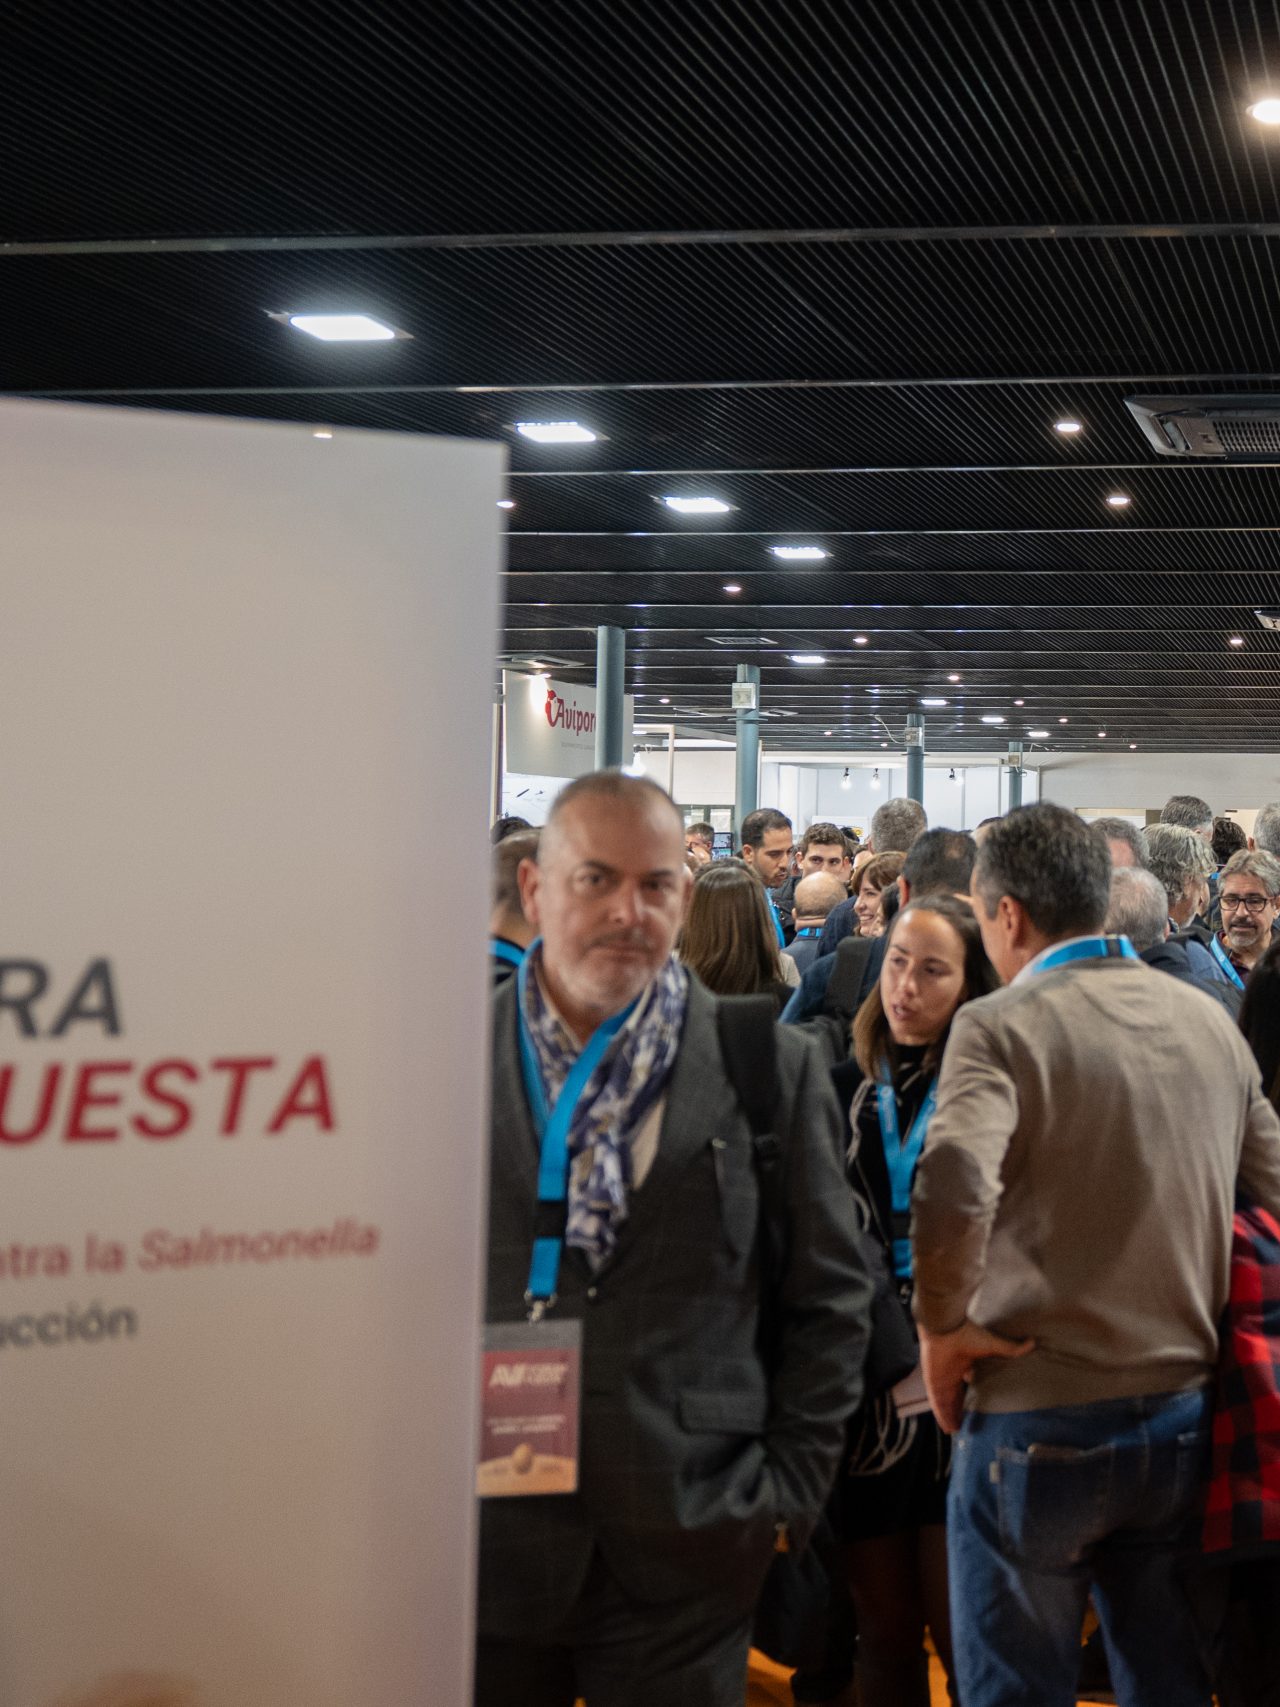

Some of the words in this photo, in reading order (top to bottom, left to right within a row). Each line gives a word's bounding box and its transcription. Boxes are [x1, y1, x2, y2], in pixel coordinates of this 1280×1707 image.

[0, 956, 122, 1039] RA
[0, 1053, 336, 1146] UESTA
[85, 1232, 126, 1274] la
[139, 1217, 380, 1272] Salmonella
